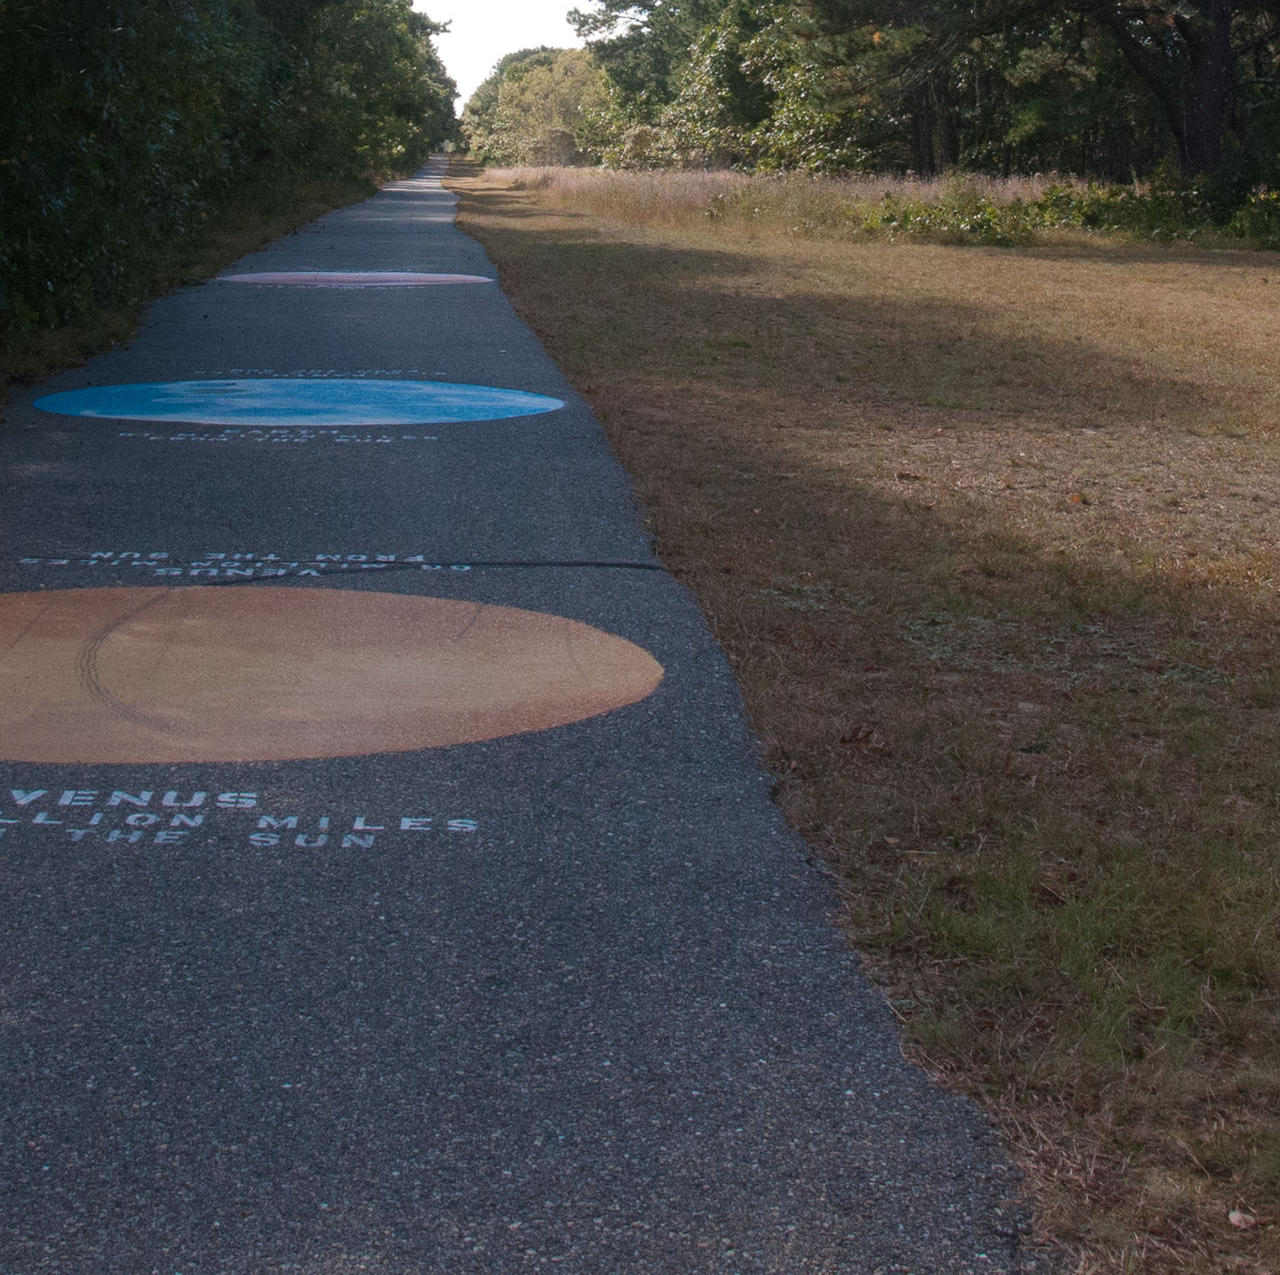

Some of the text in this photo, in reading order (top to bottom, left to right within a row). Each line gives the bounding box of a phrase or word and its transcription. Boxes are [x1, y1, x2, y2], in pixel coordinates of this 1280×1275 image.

[154, 568, 320, 576] VENUS
[10, 789, 261, 808] VENUS
[256, 816, 480, 831] MILES
[65, 829, 188, 844] THE
[247, 833, 377, 848] SUN
